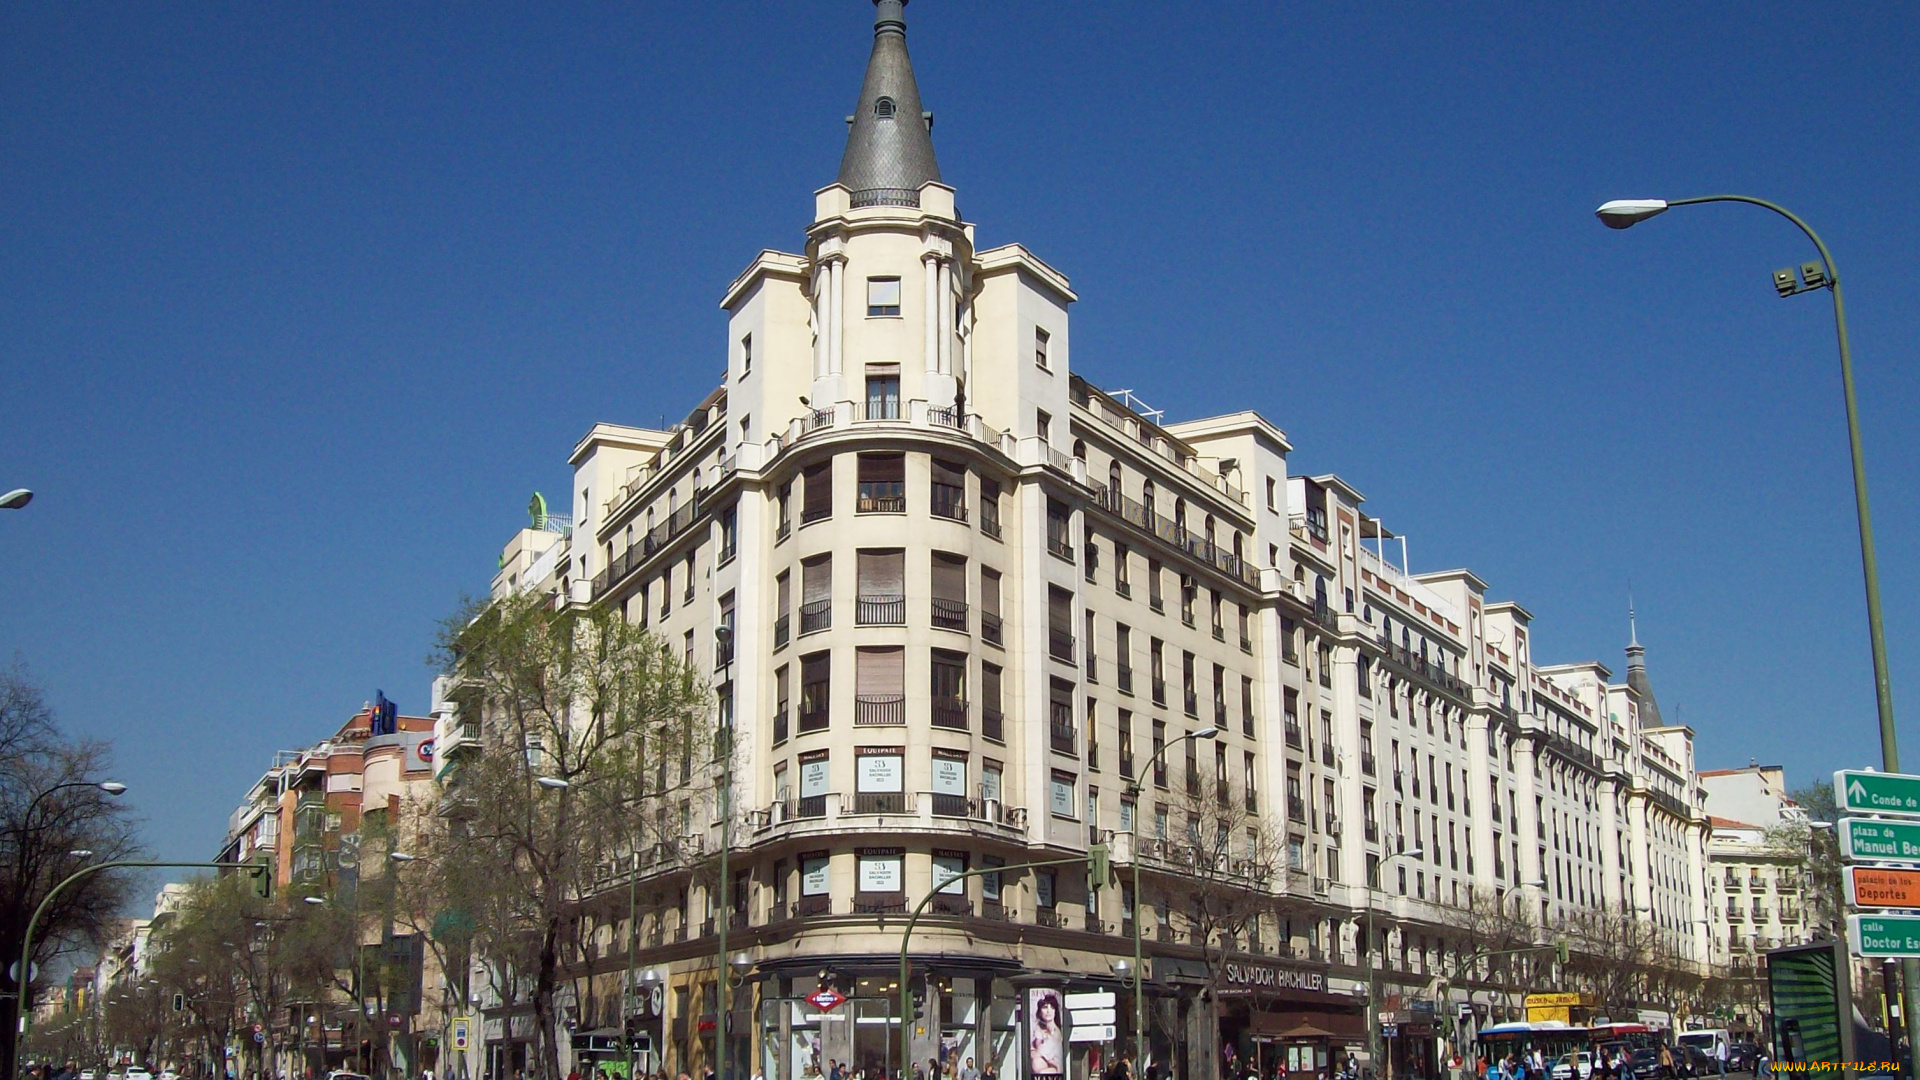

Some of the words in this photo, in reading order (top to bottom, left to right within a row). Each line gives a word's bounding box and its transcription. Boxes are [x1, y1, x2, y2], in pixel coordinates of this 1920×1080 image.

[1871, 793, 1902, 806] Conde
[1905, 796, 1918, 807] de
[1853, 825, 1878, 837] plaza
[1883, 827, 1895, 838] de
[1854, 838, 1898, 855] Manuel
[1858, 876, 1884, 884] palacio
[1901, 878, 1912, 886] los
[1859, 887, 1906, 901] Deportes
[1862, 922, 1884, 932] calle
[1863, 935, 1901, 949] Doctor
[1227, 963, 1275, 986] SALVADOR
[1278, 970, 1323, 991] BACHILLER
